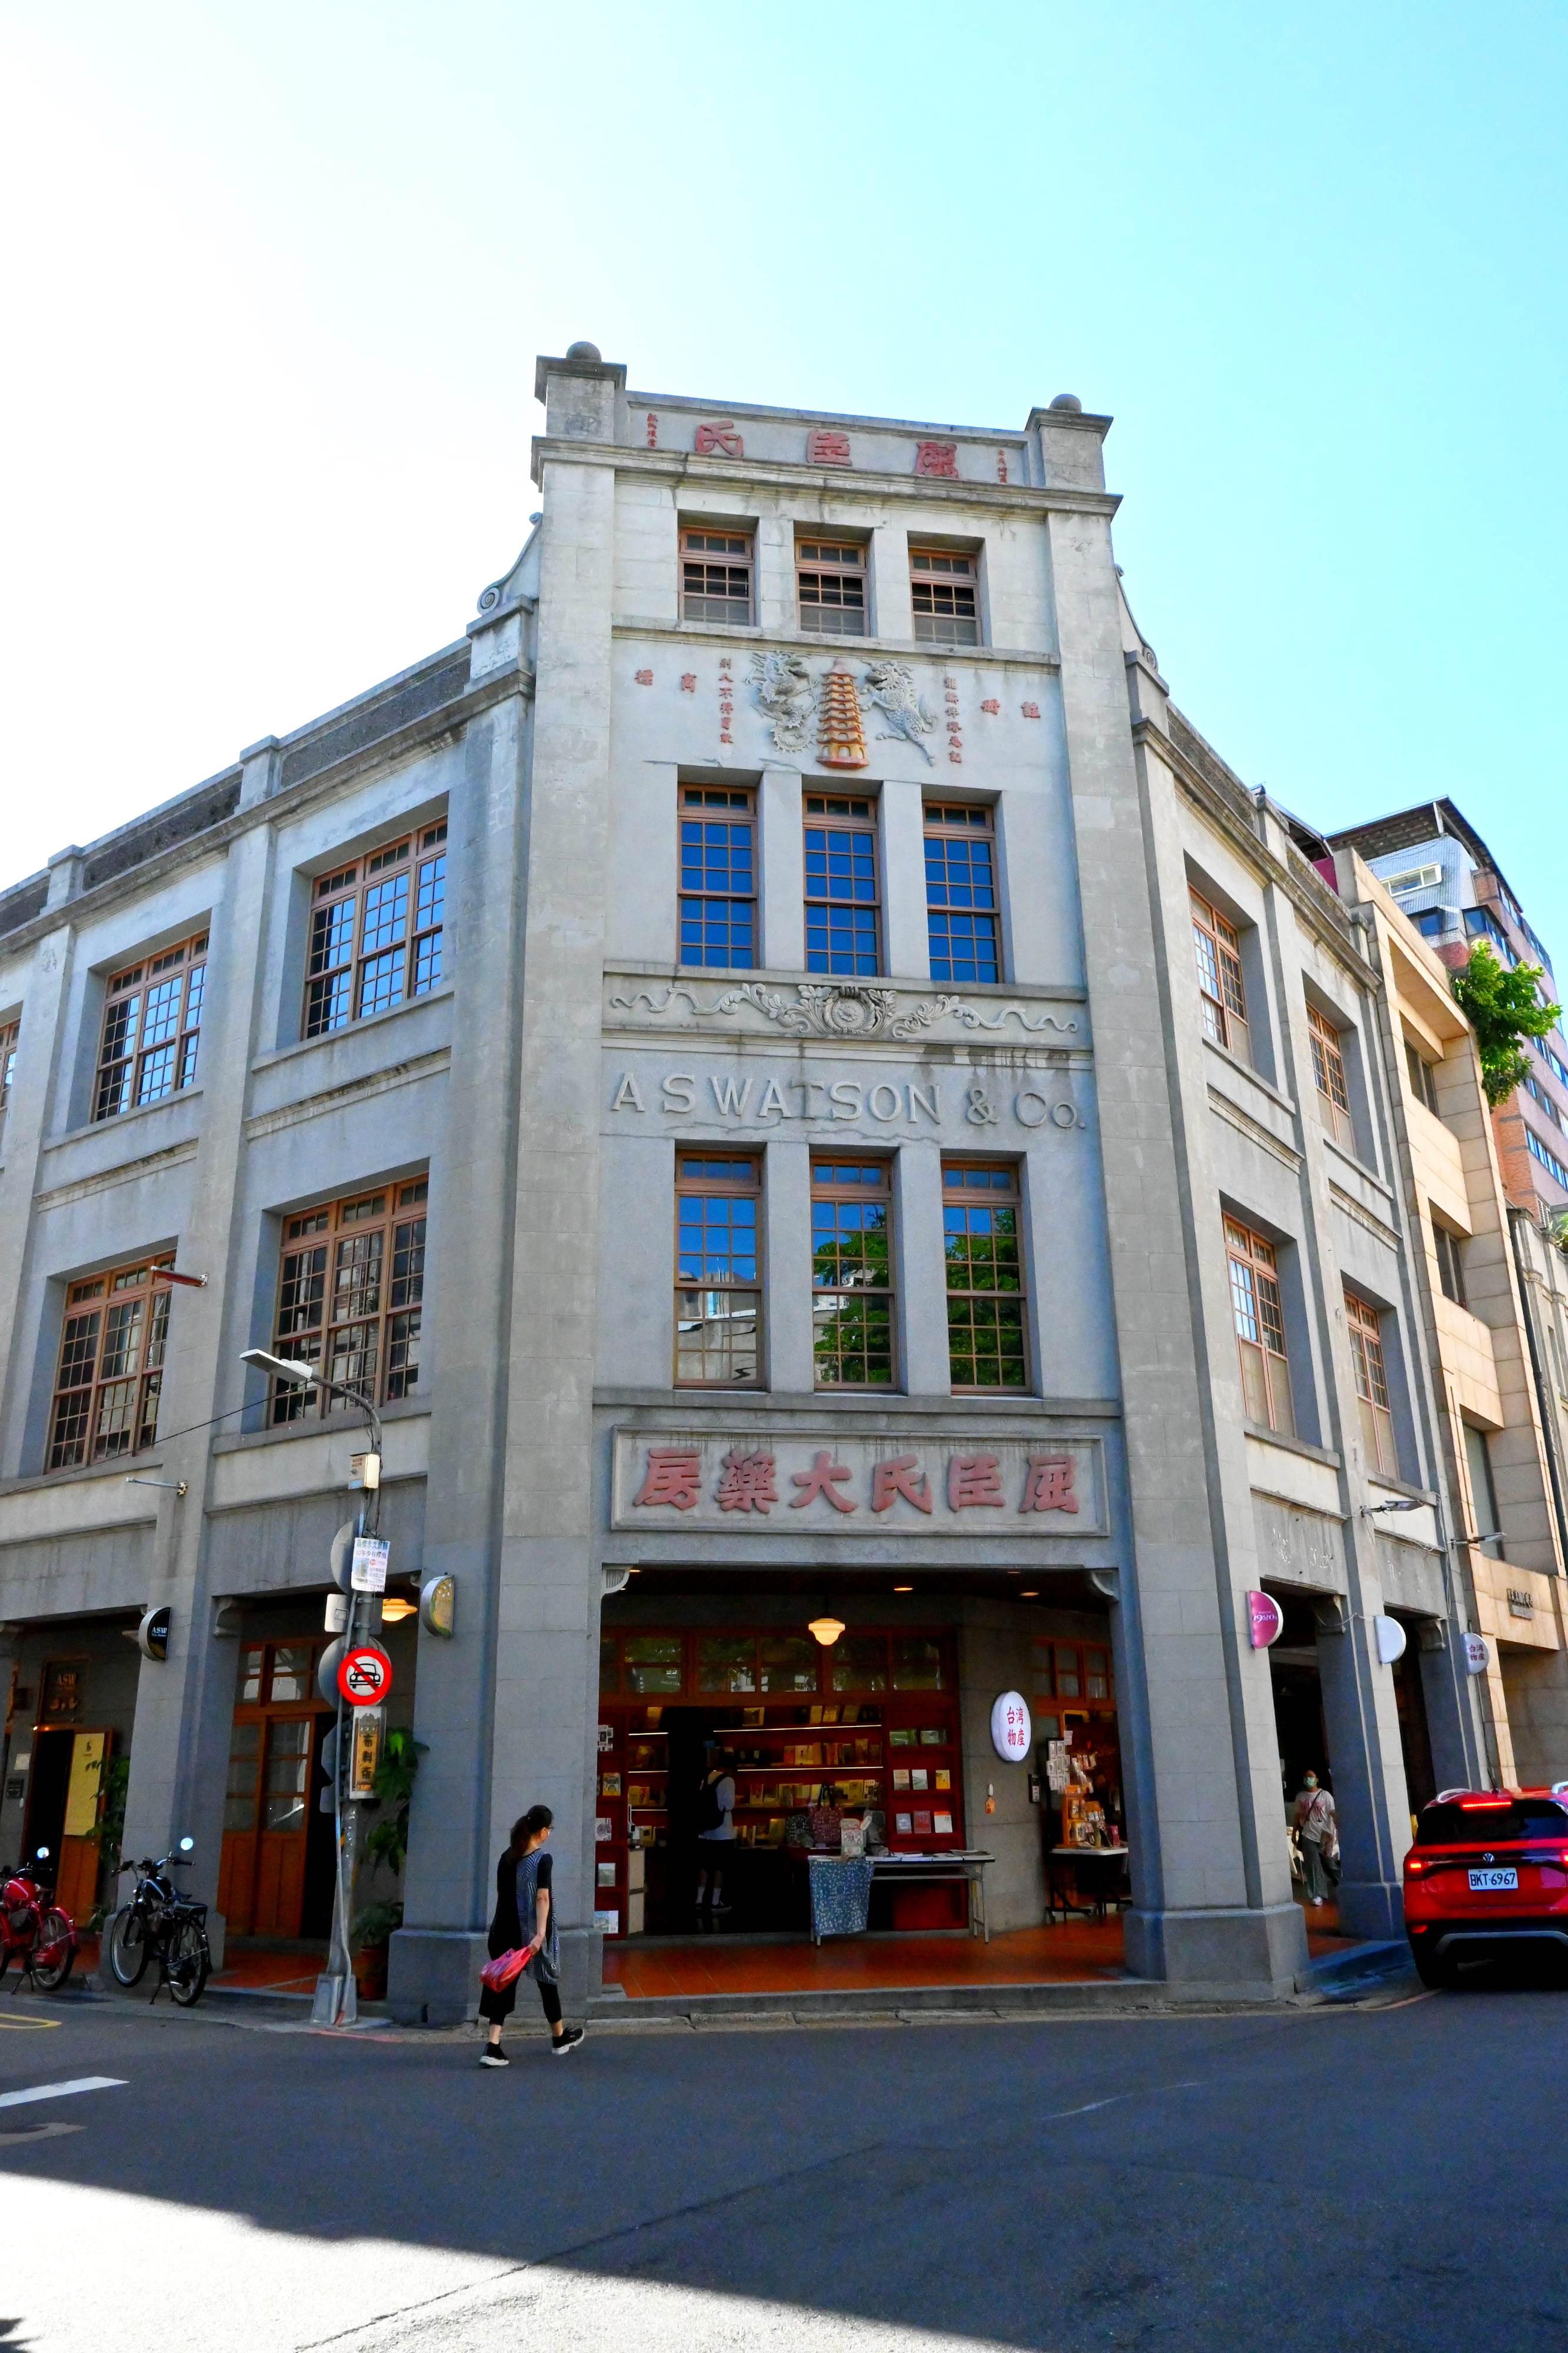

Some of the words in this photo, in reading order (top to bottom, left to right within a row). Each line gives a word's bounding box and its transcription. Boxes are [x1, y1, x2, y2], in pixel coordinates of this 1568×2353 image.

[709, 1075, 942, 1124] WATSON
[967, 1087, 1001, 1125] &
[1016, 1090, 1086, 1129] Co.
